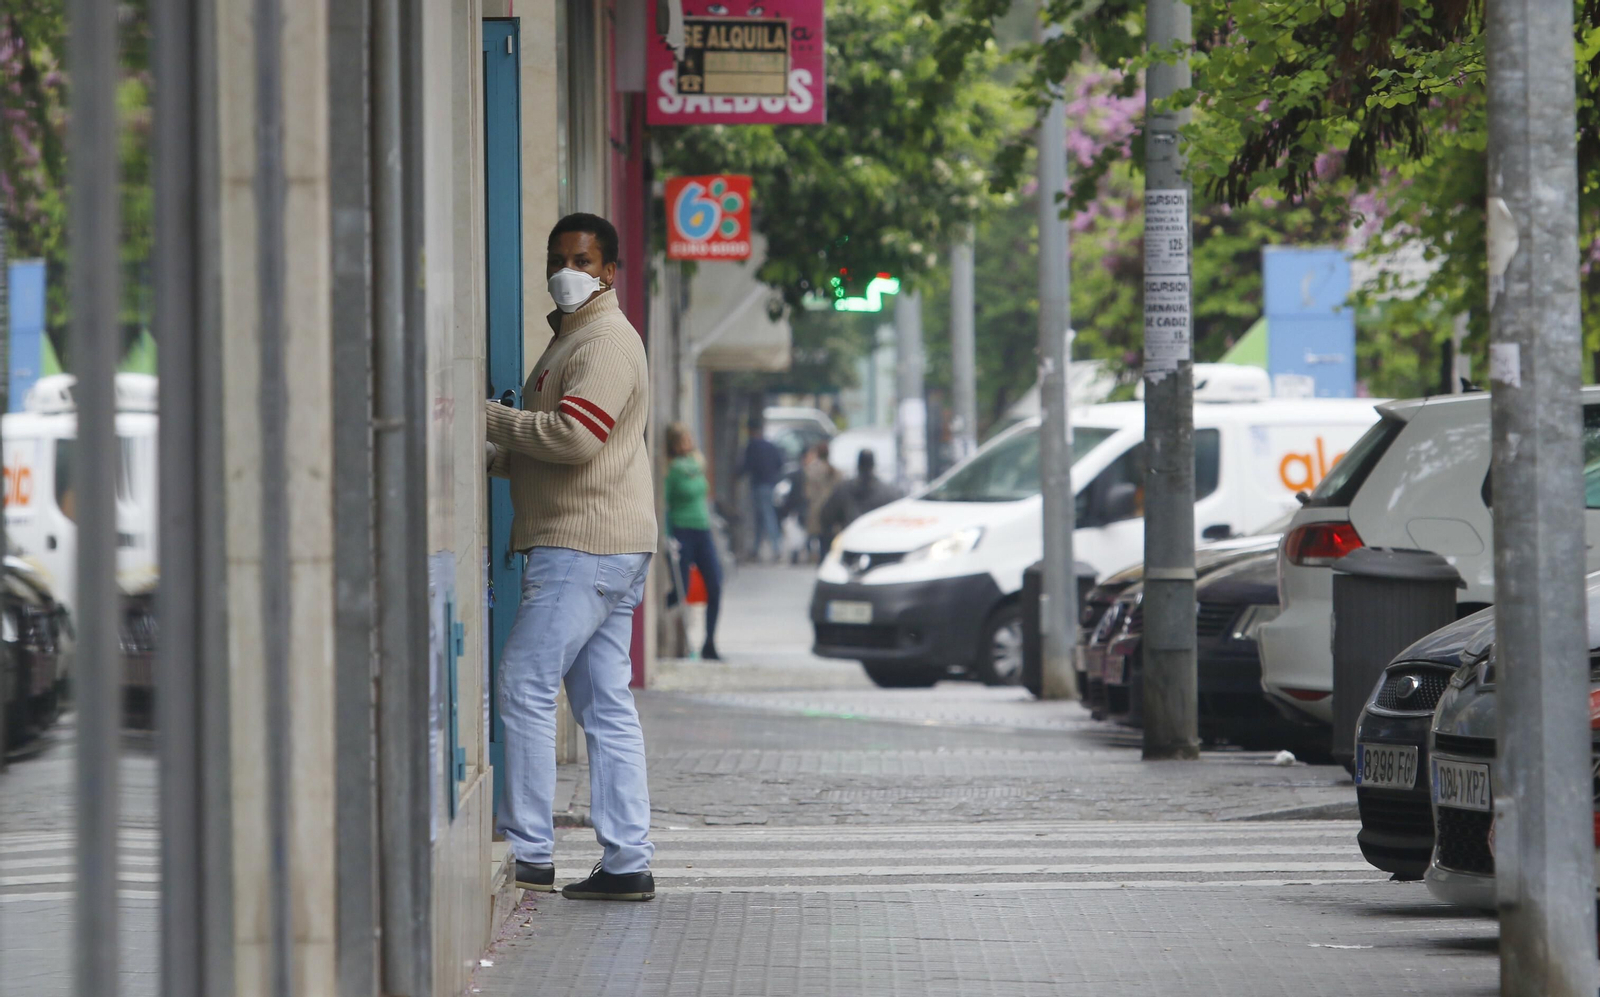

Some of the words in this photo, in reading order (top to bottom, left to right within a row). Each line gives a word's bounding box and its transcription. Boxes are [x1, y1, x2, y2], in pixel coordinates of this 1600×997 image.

[684, 24, 704, 48] SE
[707, 25, 786, 51] ALQUILA
[1157, 317, 1187, 327] CADIZ
[1279, 436, 1347, 492] al
[1364, 749, 1394, 783] 8298
[1440, 766, 1463, 802] 0841
